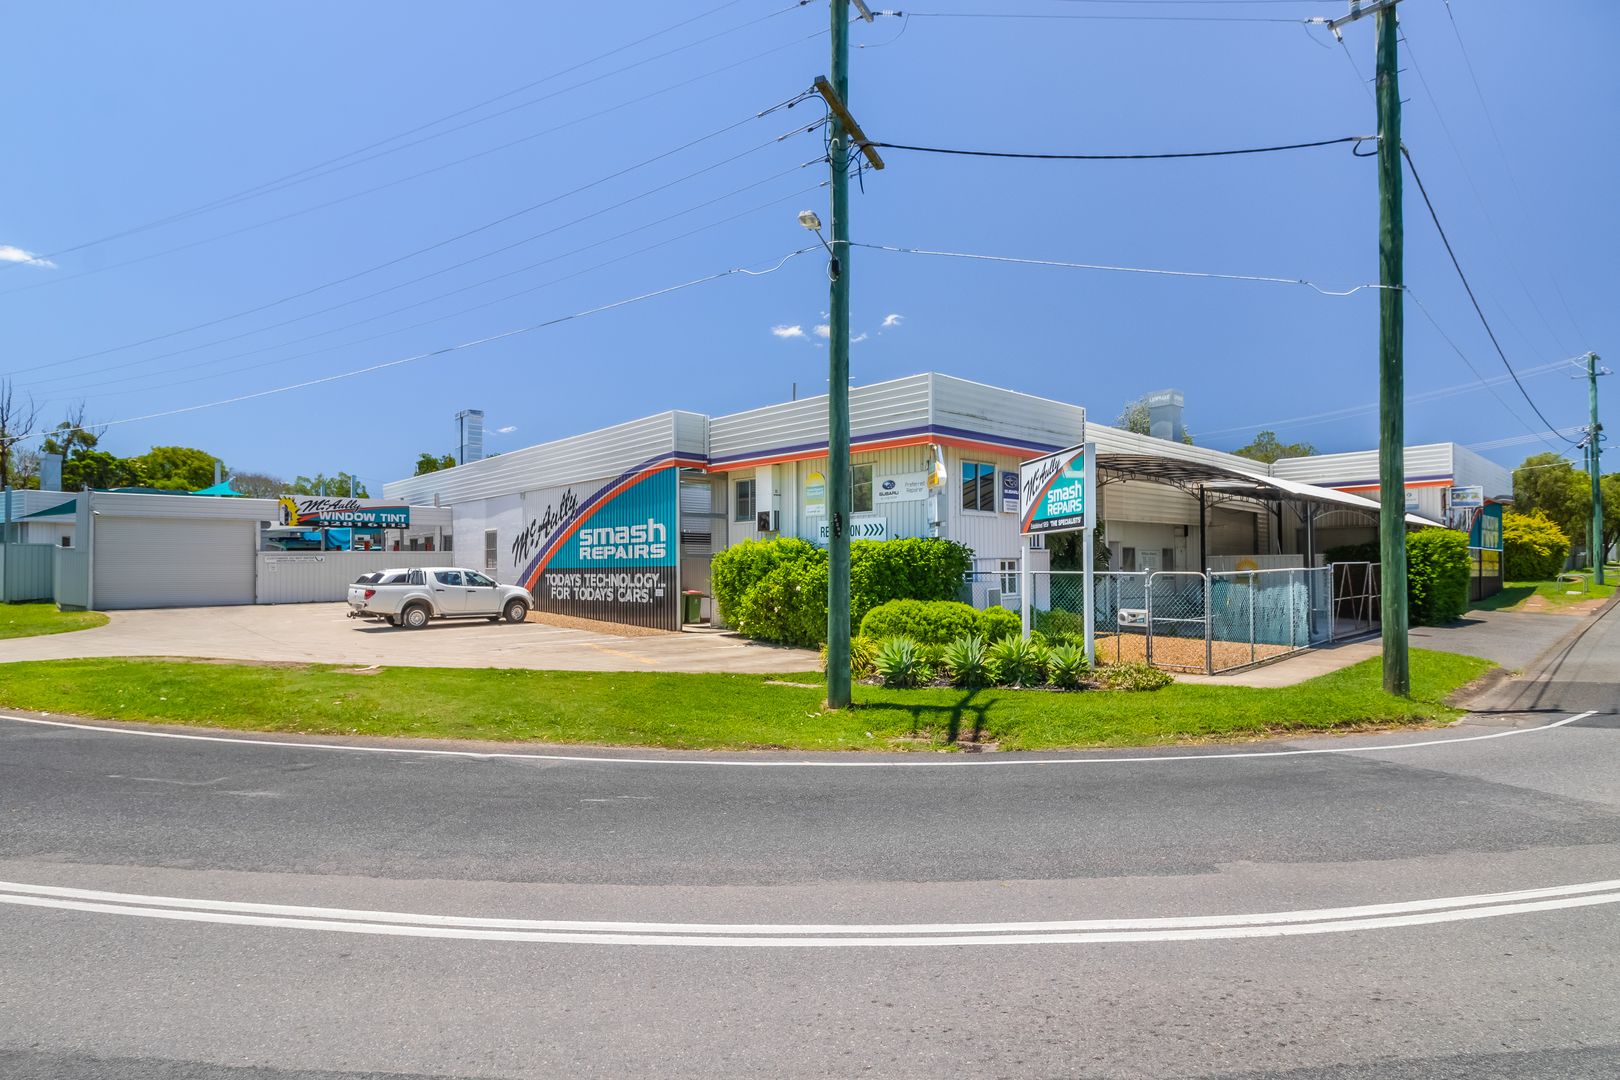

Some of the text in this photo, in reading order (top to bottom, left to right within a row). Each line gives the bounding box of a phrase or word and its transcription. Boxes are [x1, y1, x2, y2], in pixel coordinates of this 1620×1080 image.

[1047, 480, 1082, 504] smash
[300, 499, 361, 513] McAully
[1047, 498, 1082, 516] REPAIRS
[319, 511, 407, 522] WINDOW TINT
[511, 487, 578, 568] McAully
[579, 518, 666, 546] smash
[579, 543, 666, 560] REPAIRS
[545, 573, 582, 587] TODAYS
[551, 587, 653, 604] FOR TODAYS CARS.
